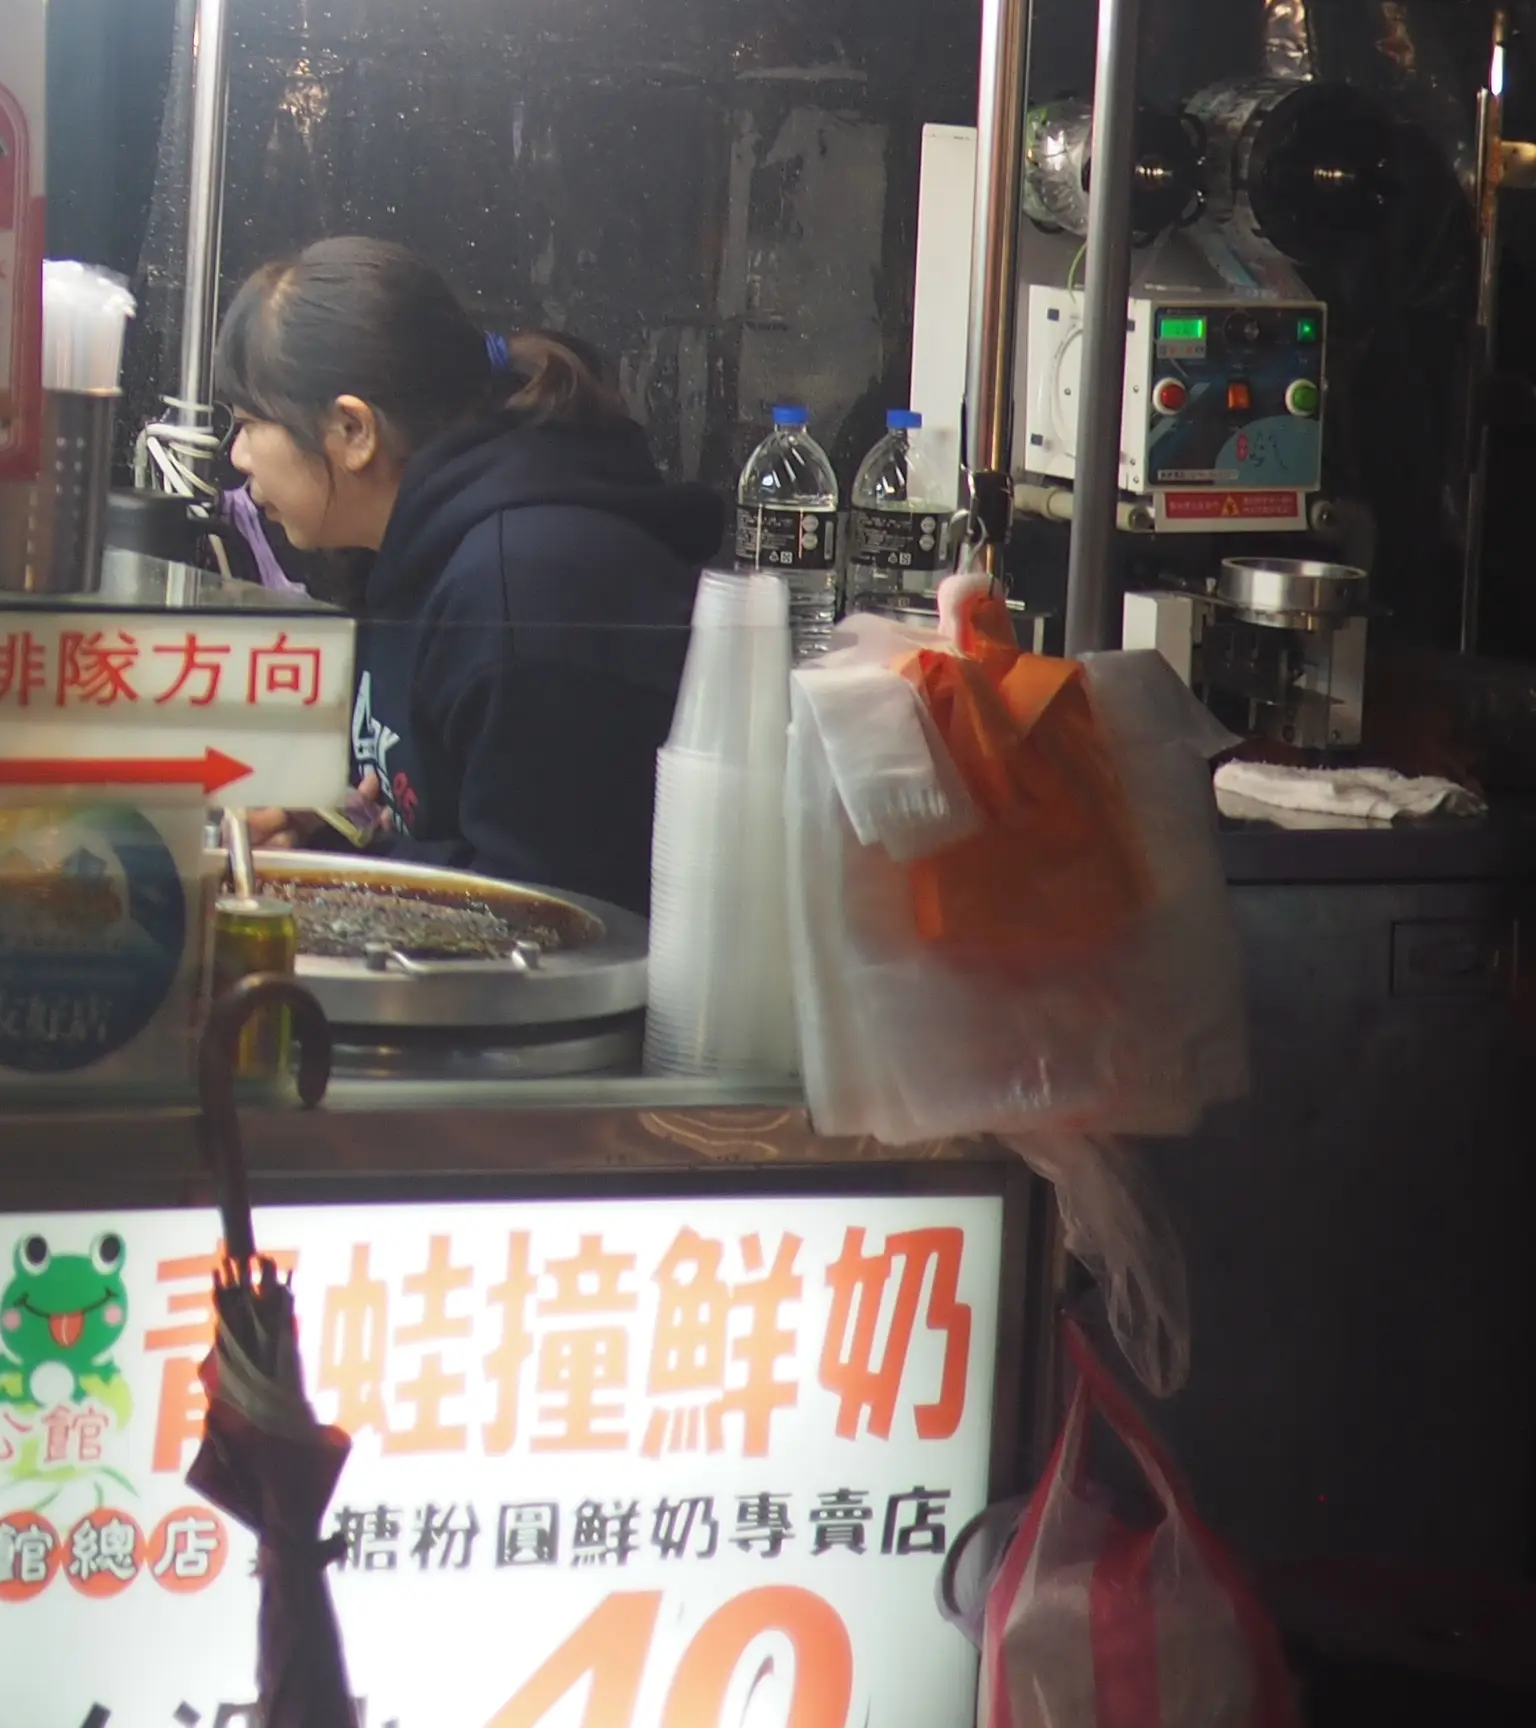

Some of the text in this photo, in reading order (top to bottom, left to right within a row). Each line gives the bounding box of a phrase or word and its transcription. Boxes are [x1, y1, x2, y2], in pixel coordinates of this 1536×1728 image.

[323, 1486, 955, 1573] 糖粉圓鮮奶專賣店
[481, 1584, 854, 1728] 40
